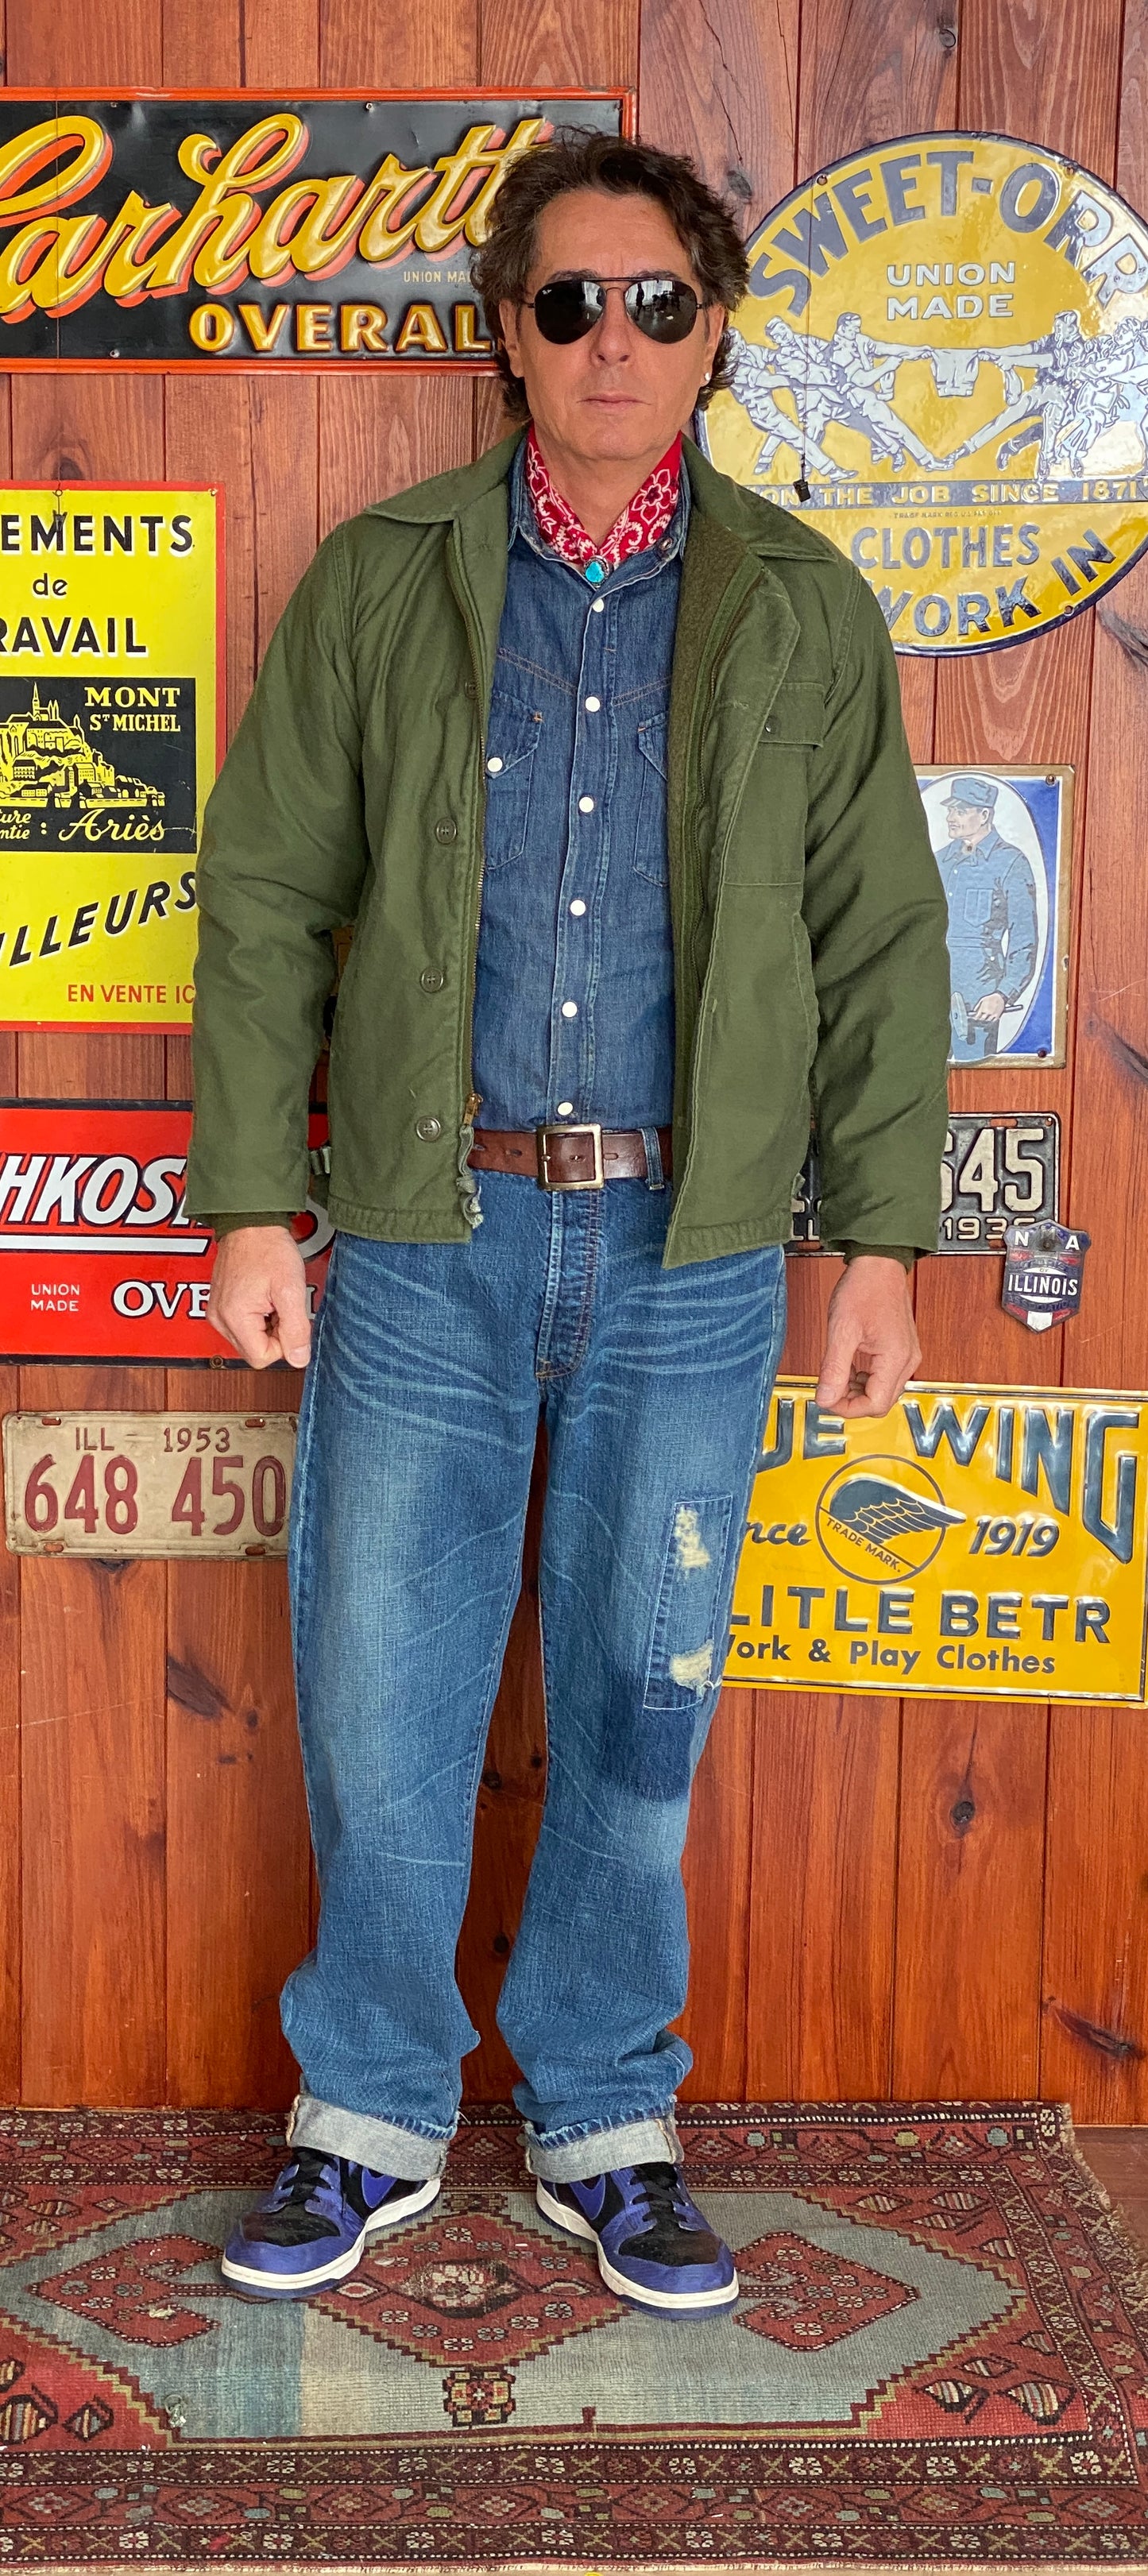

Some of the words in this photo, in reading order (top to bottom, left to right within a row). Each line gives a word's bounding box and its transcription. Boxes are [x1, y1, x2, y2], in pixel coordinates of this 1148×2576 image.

[748, 150, 1148, 316] SWEET-ORR
[404, 270, 442, 283] UNION
[886, 261, 1016, 288] UNION
[886, 293, 1015, 321] MADE
[188, 303, 505, 353] OVERAL
[819, 486, 874, 506] THE
[891, 485, 951, 505] JOB
[972, 482, 1060, 503] SINCE
[0, 513, 193, 553] EMENTS
[851, 523, 1041, 570] CLOTHES
[1050, 528, 1117, 596] IN
[33, 572, 68, 597] de
[83, 687, 181, 708] MONT
[112, 714, 181, 733] MICHEL
[0, 810, 32, 825] ure
[58, 808, 165, 842] Ariès
[68, 984, 95, 1003] EN
[100, 984, 167, 1004] VENTE
[2, 1155, 203, 1226] HKOS
[790, 1218, 821, 1241] LL
[1014, 1231, 1030, 1247] N
[1065, 1235, 1080, 1251] A
[31, 1283, 80, 1296] UNION
[1007, 1274, 1079, 1297] ILLINOIS
[30, 1299, 79, 1312] MADE
[75, 1426, 115, 1451] ILL
[164, 1426, 230, 1453] 1953
[25, 1452, 139, 1536] 648
[171, 1453, 287, 1537] 450
[902, 1402, 1140, 1565] WING
[745, 1520, 812, 1547] nce
[968, 1514, 1060, 1558] 1919
[826, 1517, 864, 1547] TRADE
[941, 1591, 1111, 1645] BETR
[728, 1634, 792, 1661] ork
[808, 1638, 832, 1663] &
[850, 1640, 922, 1676] Play
[937, 1645, 1057, 1675] Clothes
